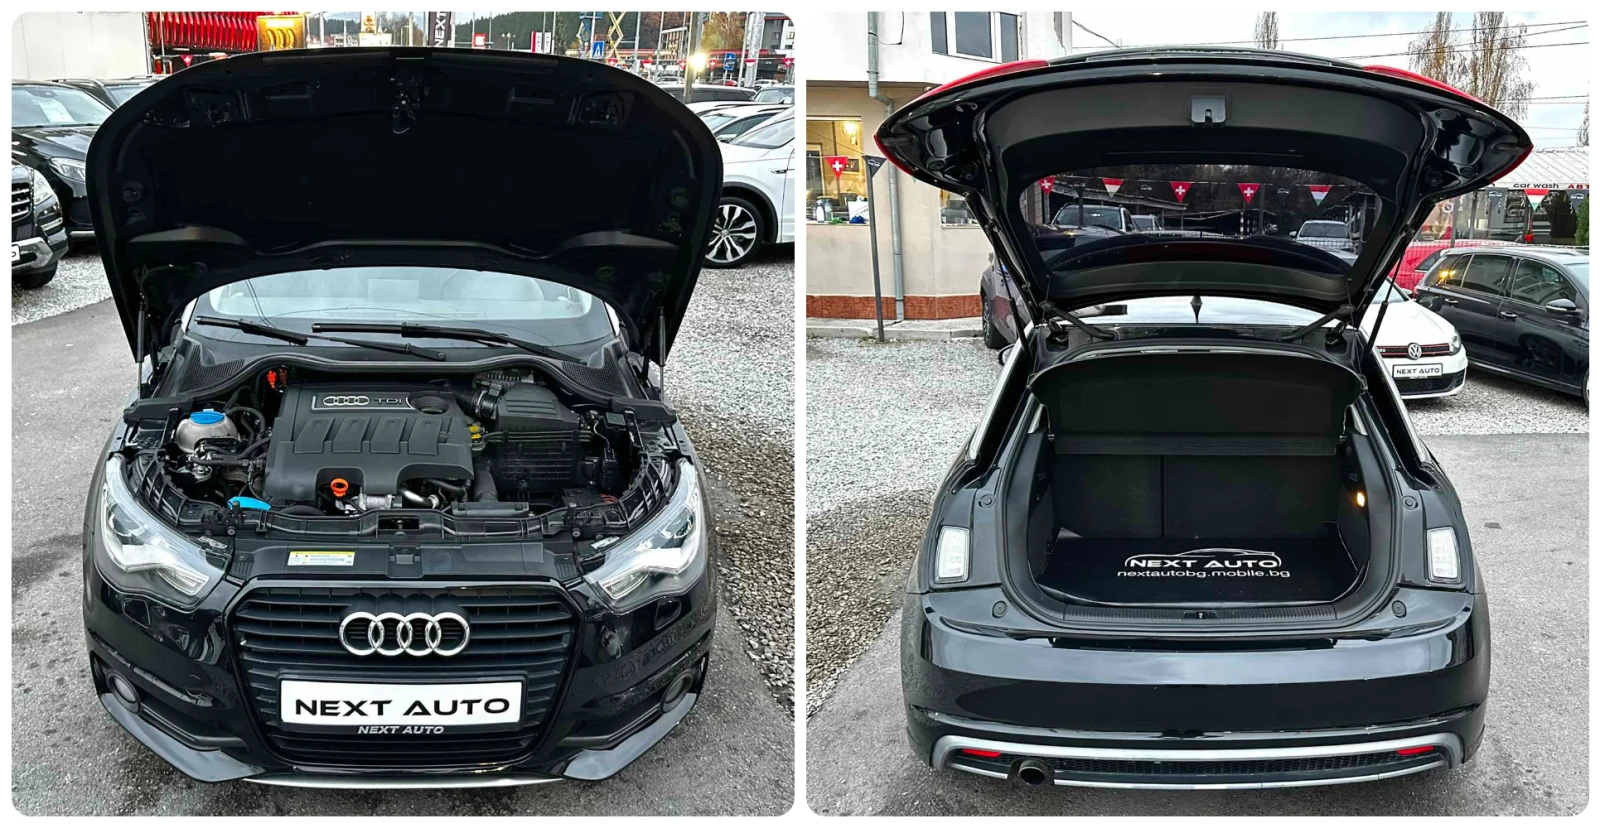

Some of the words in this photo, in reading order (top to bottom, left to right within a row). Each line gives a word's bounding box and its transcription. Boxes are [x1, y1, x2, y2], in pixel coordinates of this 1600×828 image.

[434, 11, 447, 47] NEXT
[374, 397, 403, 405] TDI
[1129, 559, 1199, 568] NEXT
[1203, 559, 1279, 568] AUTO
[1117, 569, 1291, 578] nextautobg.mobile.bg
[295, 698, 393, 717] NEXT
[403, 697, 511, 716] AUTO
[357, 725, 400, 734] NEXT
[401, 725, 445, 734] AUTO
